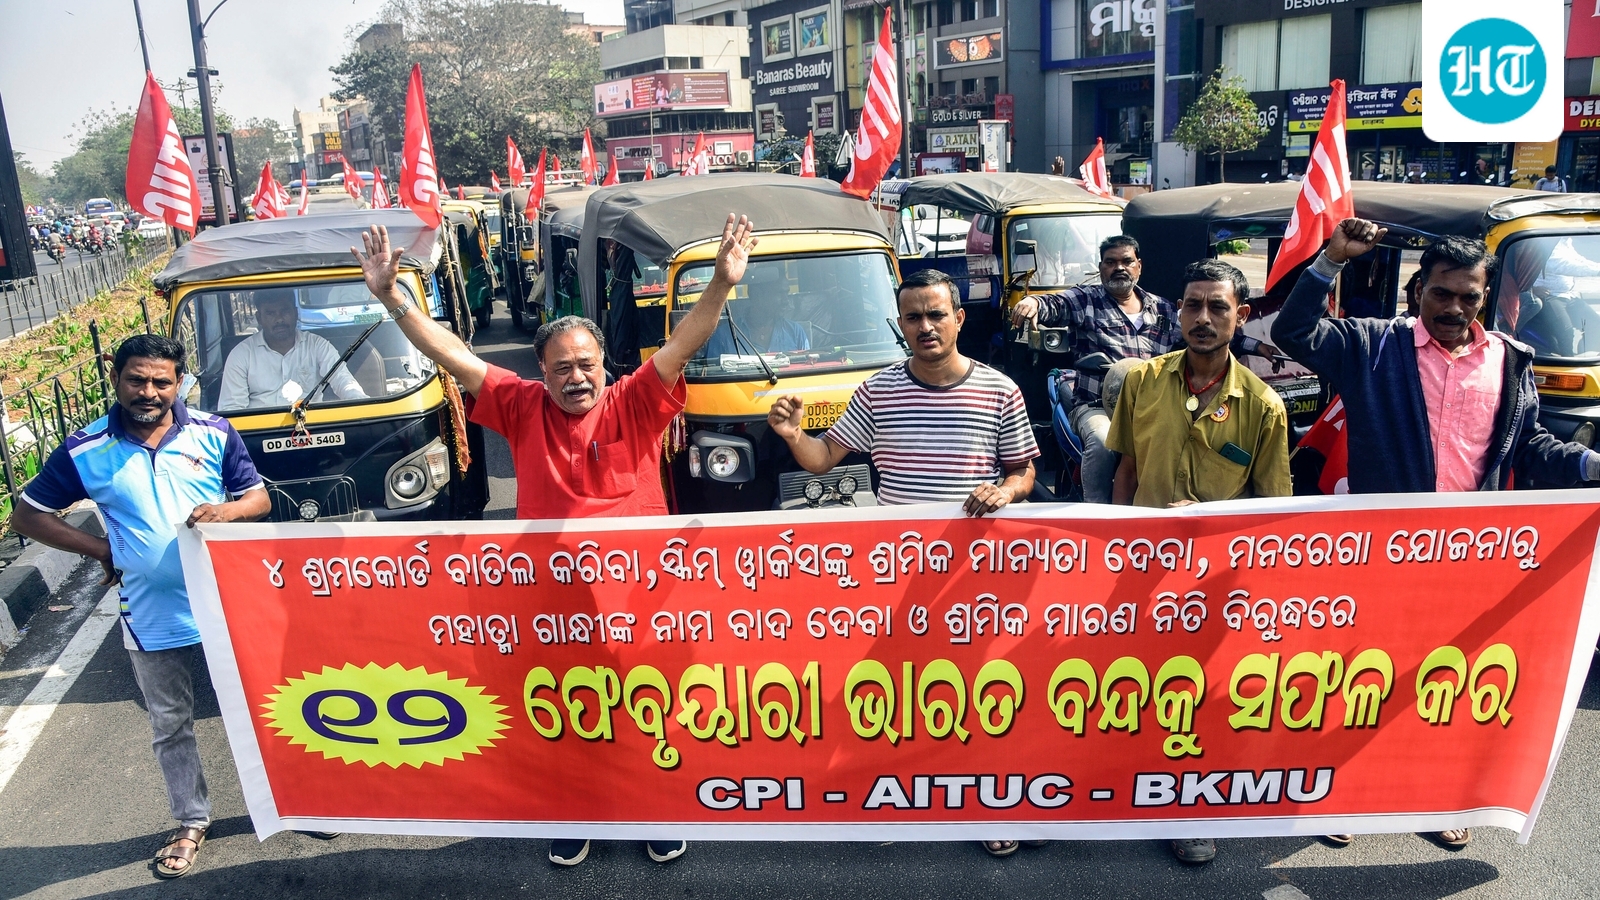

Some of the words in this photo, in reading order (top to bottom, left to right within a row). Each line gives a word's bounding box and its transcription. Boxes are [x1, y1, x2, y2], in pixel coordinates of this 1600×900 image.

[756, 68, 795, 85] Banaras
[795, 59, 832, 79] Beauty
[769, 86, 787, 97] SAREE
[788, 82, 819, 94] SHOWROOM
[1347, 89, 1379, 104] इंडियन
[1380, 87, 1398, 100] बैंक
[932, 112, 952, 122] GOLD
[959, 110, 982, 120] SILVER
[325, 137, 342, 145] GOLD
[945, 134, 977, 145] RATAN
[807, 404, 842, 416] OD05C
[267, 440, 283, 450] OD
[316, 434, 342, 445] 5403
[262, 559, 283, 587] ୪
[302, 540, 430, 594] ଶ୍ରମକୋର୍ଡ
[445, 543, 535, 584] ବାତିଲ
[869, 531, 952, 582] ଶ୍ରମିକ
[969, 539, 1086, 571] ମାନ୍ୟତା
[1104, 538, 1208, 578] ଦେବା,
[1229, 532, 1371, 567] ମନରେଗା
[1387, 526, 1539, 569] ଯୋଜନାରୁ
[429, 615, 518, 653] ମହାତ୍ମା
[533, 612, 635, 643] ଗାନ୍ଧୀଙ୍କ
[651, 610, 712, 640] ନାମ
[728, 608, 791, 639] ବାଦ
[807, 606, 890, 637] ଦେବା
[908, 604, 927, 634] ଓ
[945, 593, 1028, 642] ଶ୍ରମିକ
[1044, 603, 1136, 634] ମାରଣ
[1153, 591, 1206, 631] ନିତି
[1223, 590, 1355, 640] ବିରୁଦ୍ଧରେ
[524, 661, 820, 767] ଫେବୃୟାରୀ
[844, 659, 1023, 743] ଭାରତ
[1048, 656, 1204, 756] ବନ୍ଦକୁ
[1229, 649, 1393, 729] ସଫଳ
[1416, 643, 1516, 725] କର
[697, 778, 804, 810] CPI
[864, 774, 1072, 809] AITUC
[1133, 768, 1333, 807] BKMU
